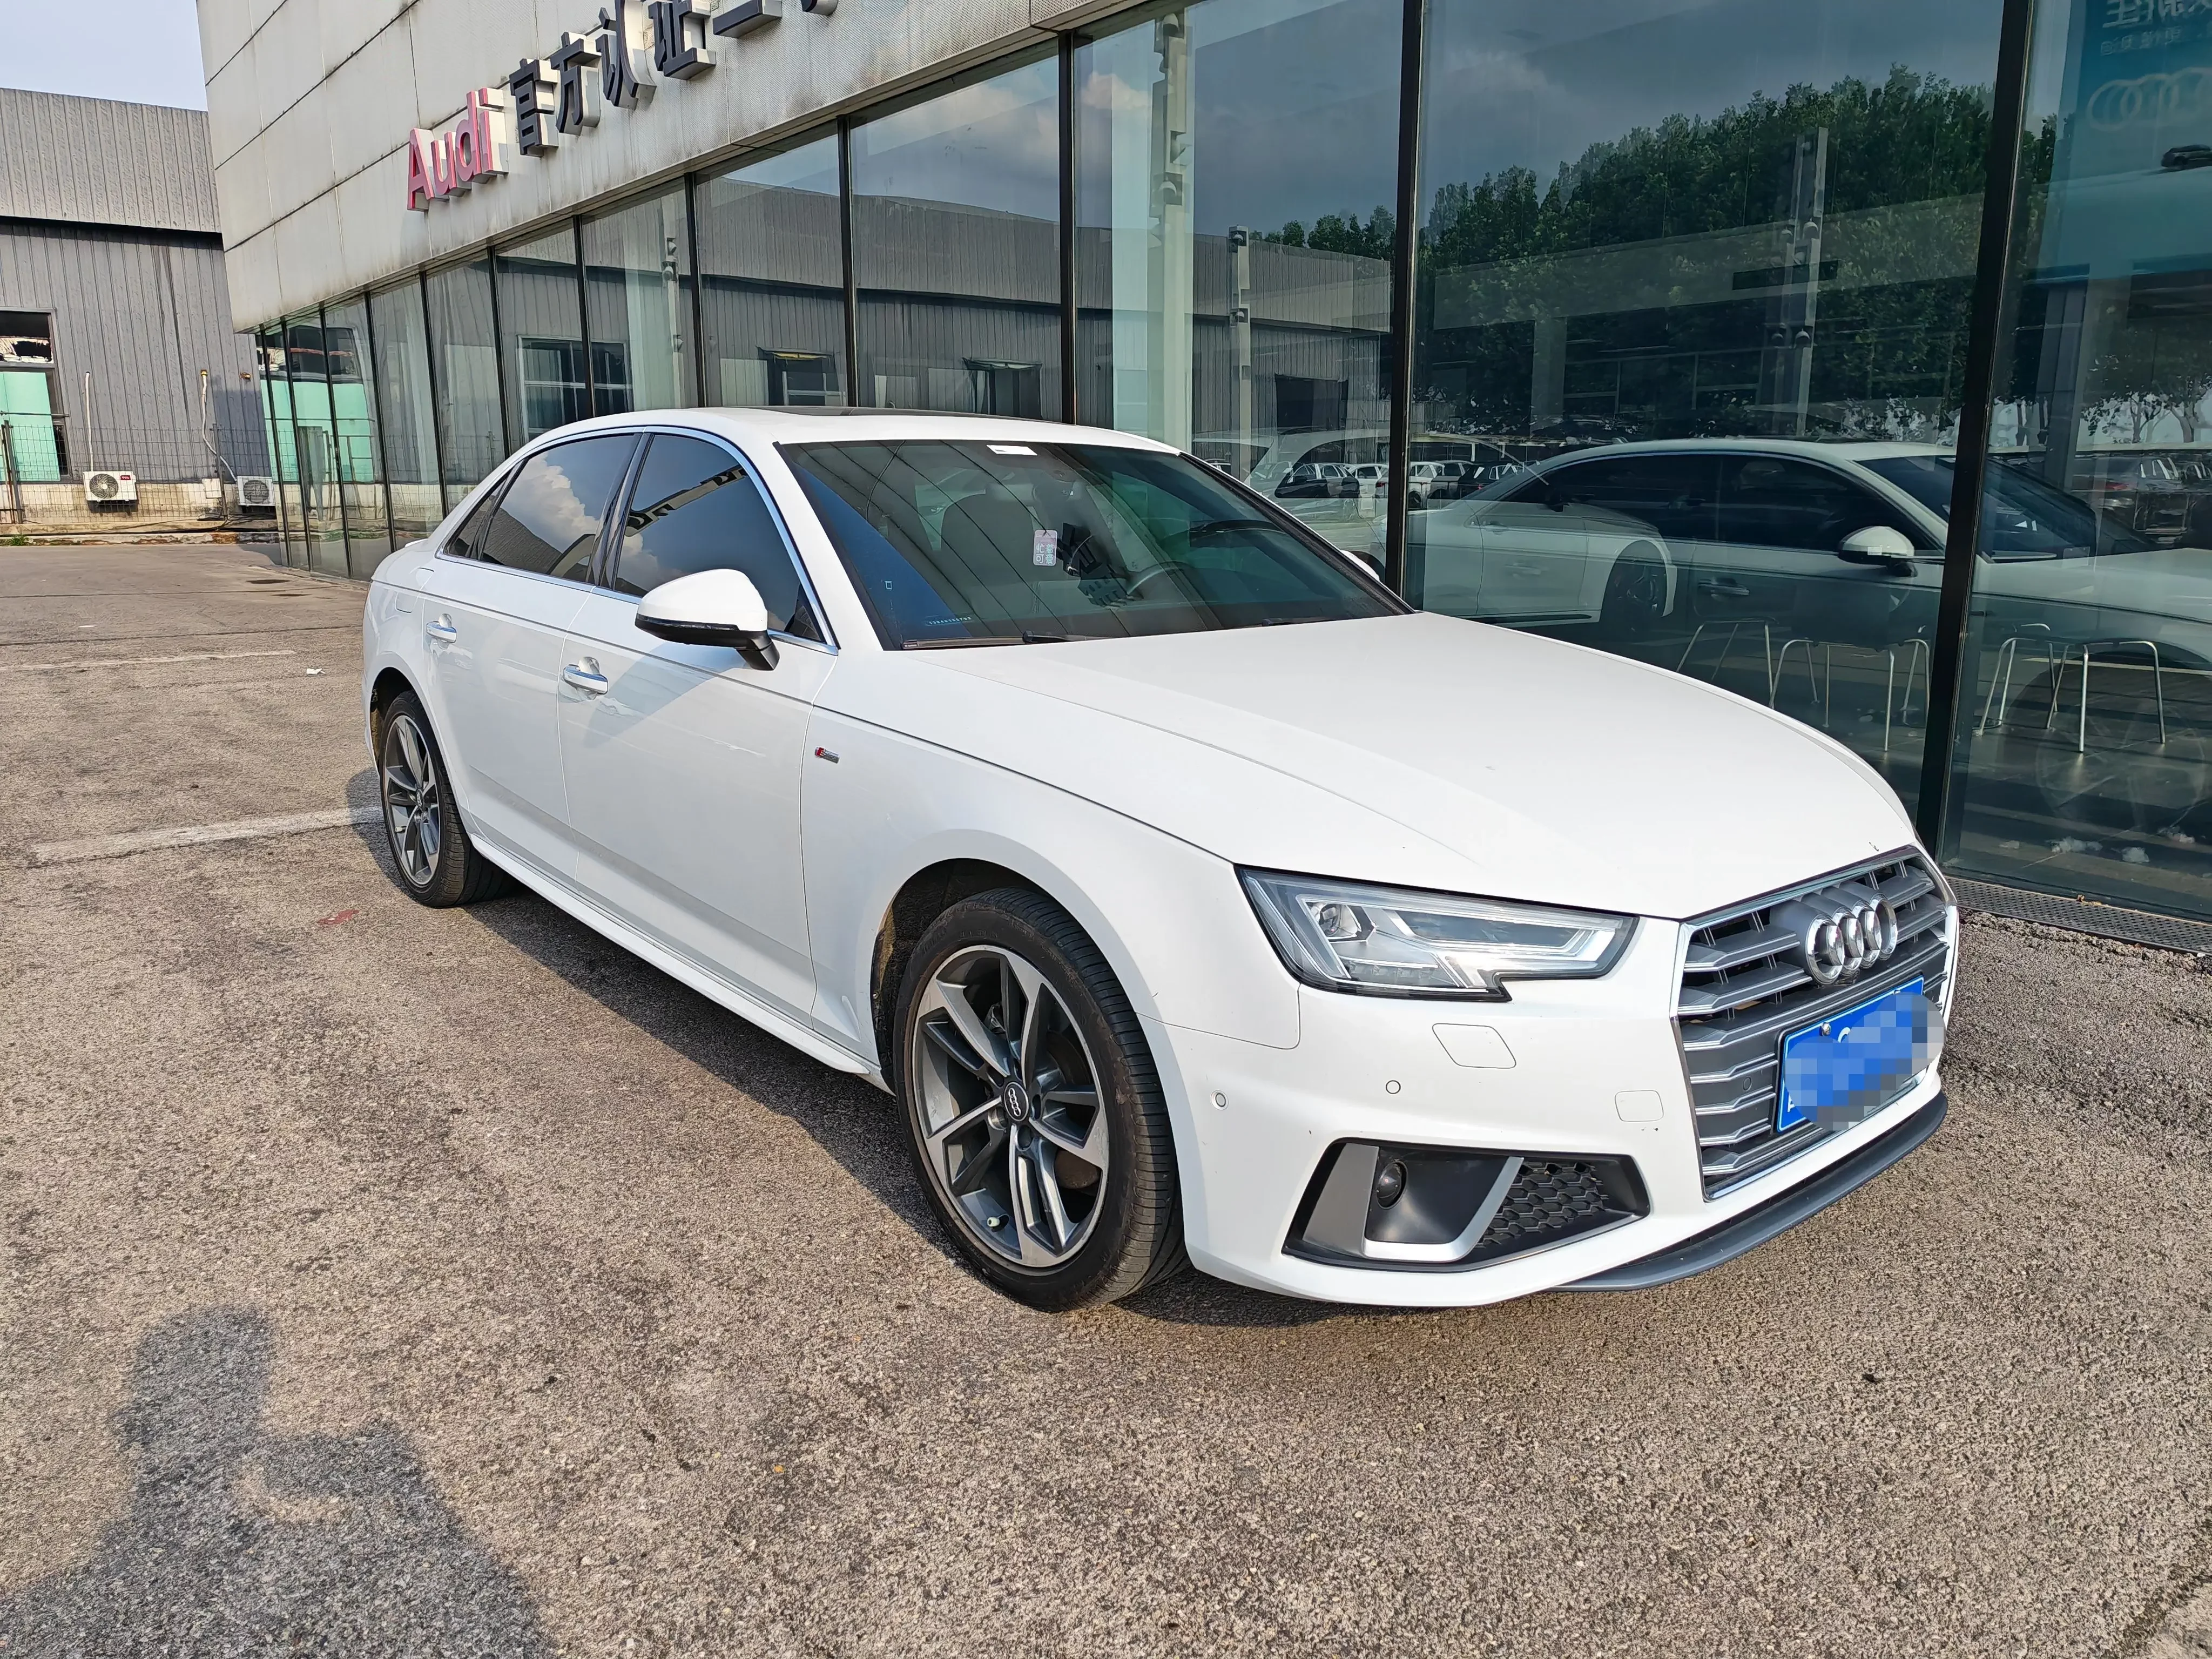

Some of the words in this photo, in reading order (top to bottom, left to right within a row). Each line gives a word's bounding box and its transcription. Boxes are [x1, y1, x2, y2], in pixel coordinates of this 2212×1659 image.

[407, 88, 502, 210] Audi
[509, 0, 821, 157] 官方认证
[1036, 542, 1055, 554] 忙着
[1036, 554, 1054, 565] 可爱
